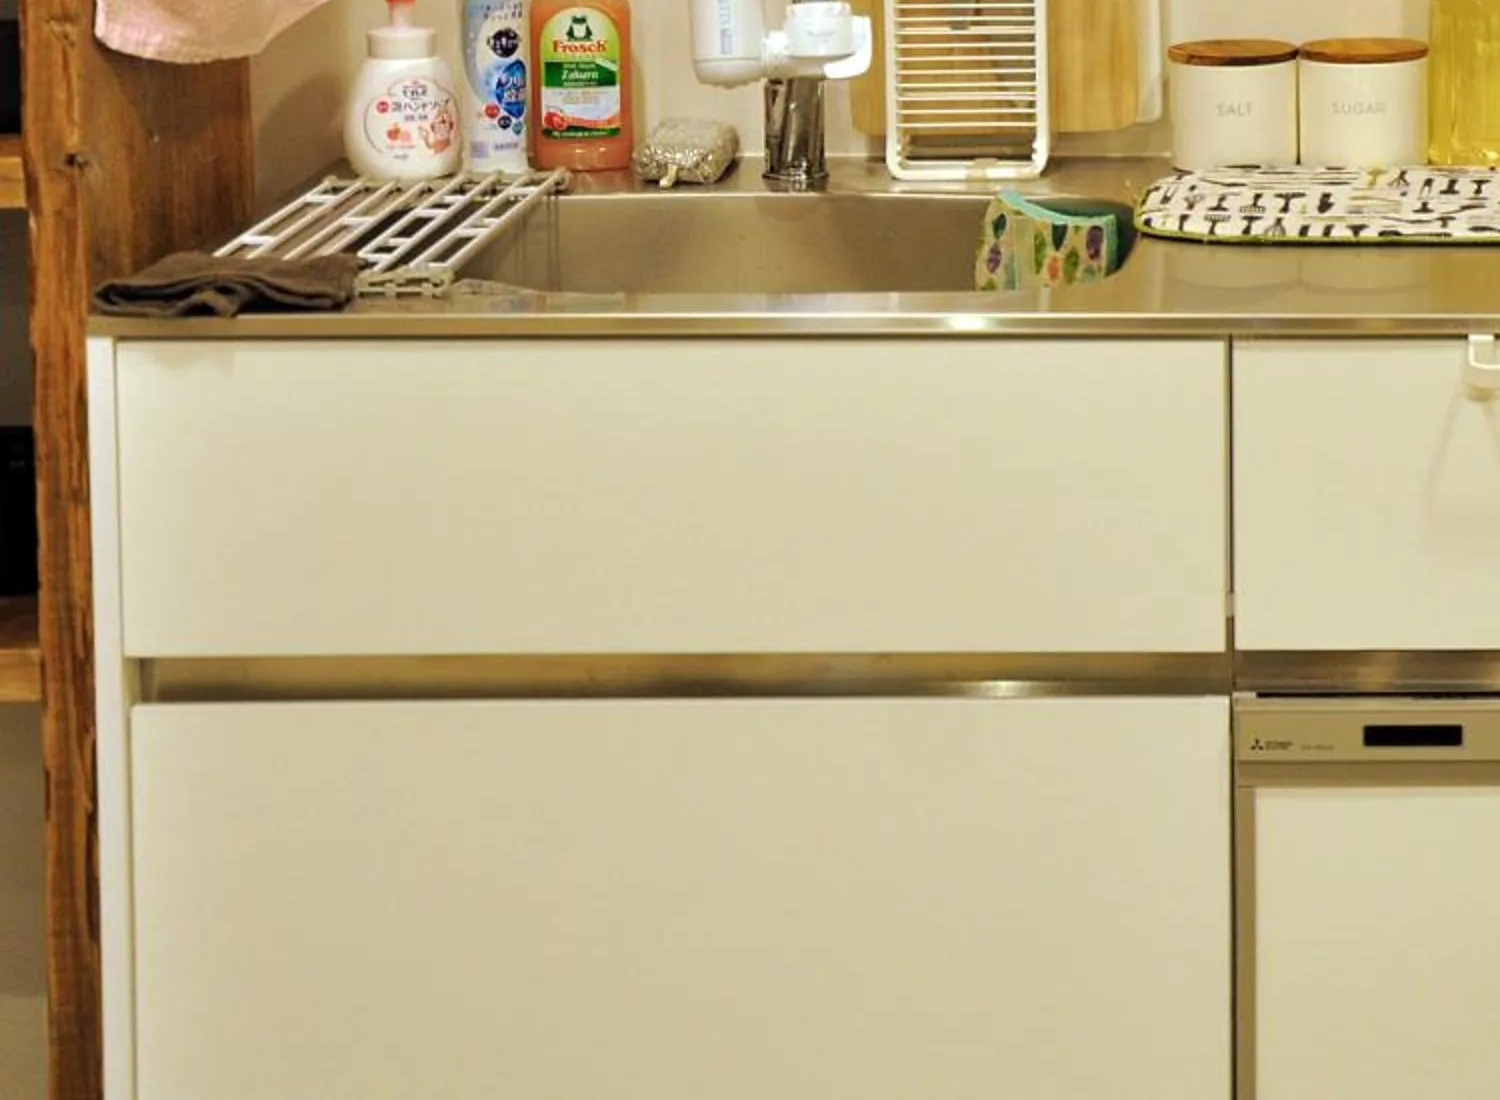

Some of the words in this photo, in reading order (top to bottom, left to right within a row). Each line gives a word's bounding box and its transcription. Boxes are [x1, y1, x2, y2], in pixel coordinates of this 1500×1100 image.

[553, 39, 607, 53] Frosch
[1216, 103, 1251, 117] SALT
[1332, 102, 1387, 115] SUGAR
